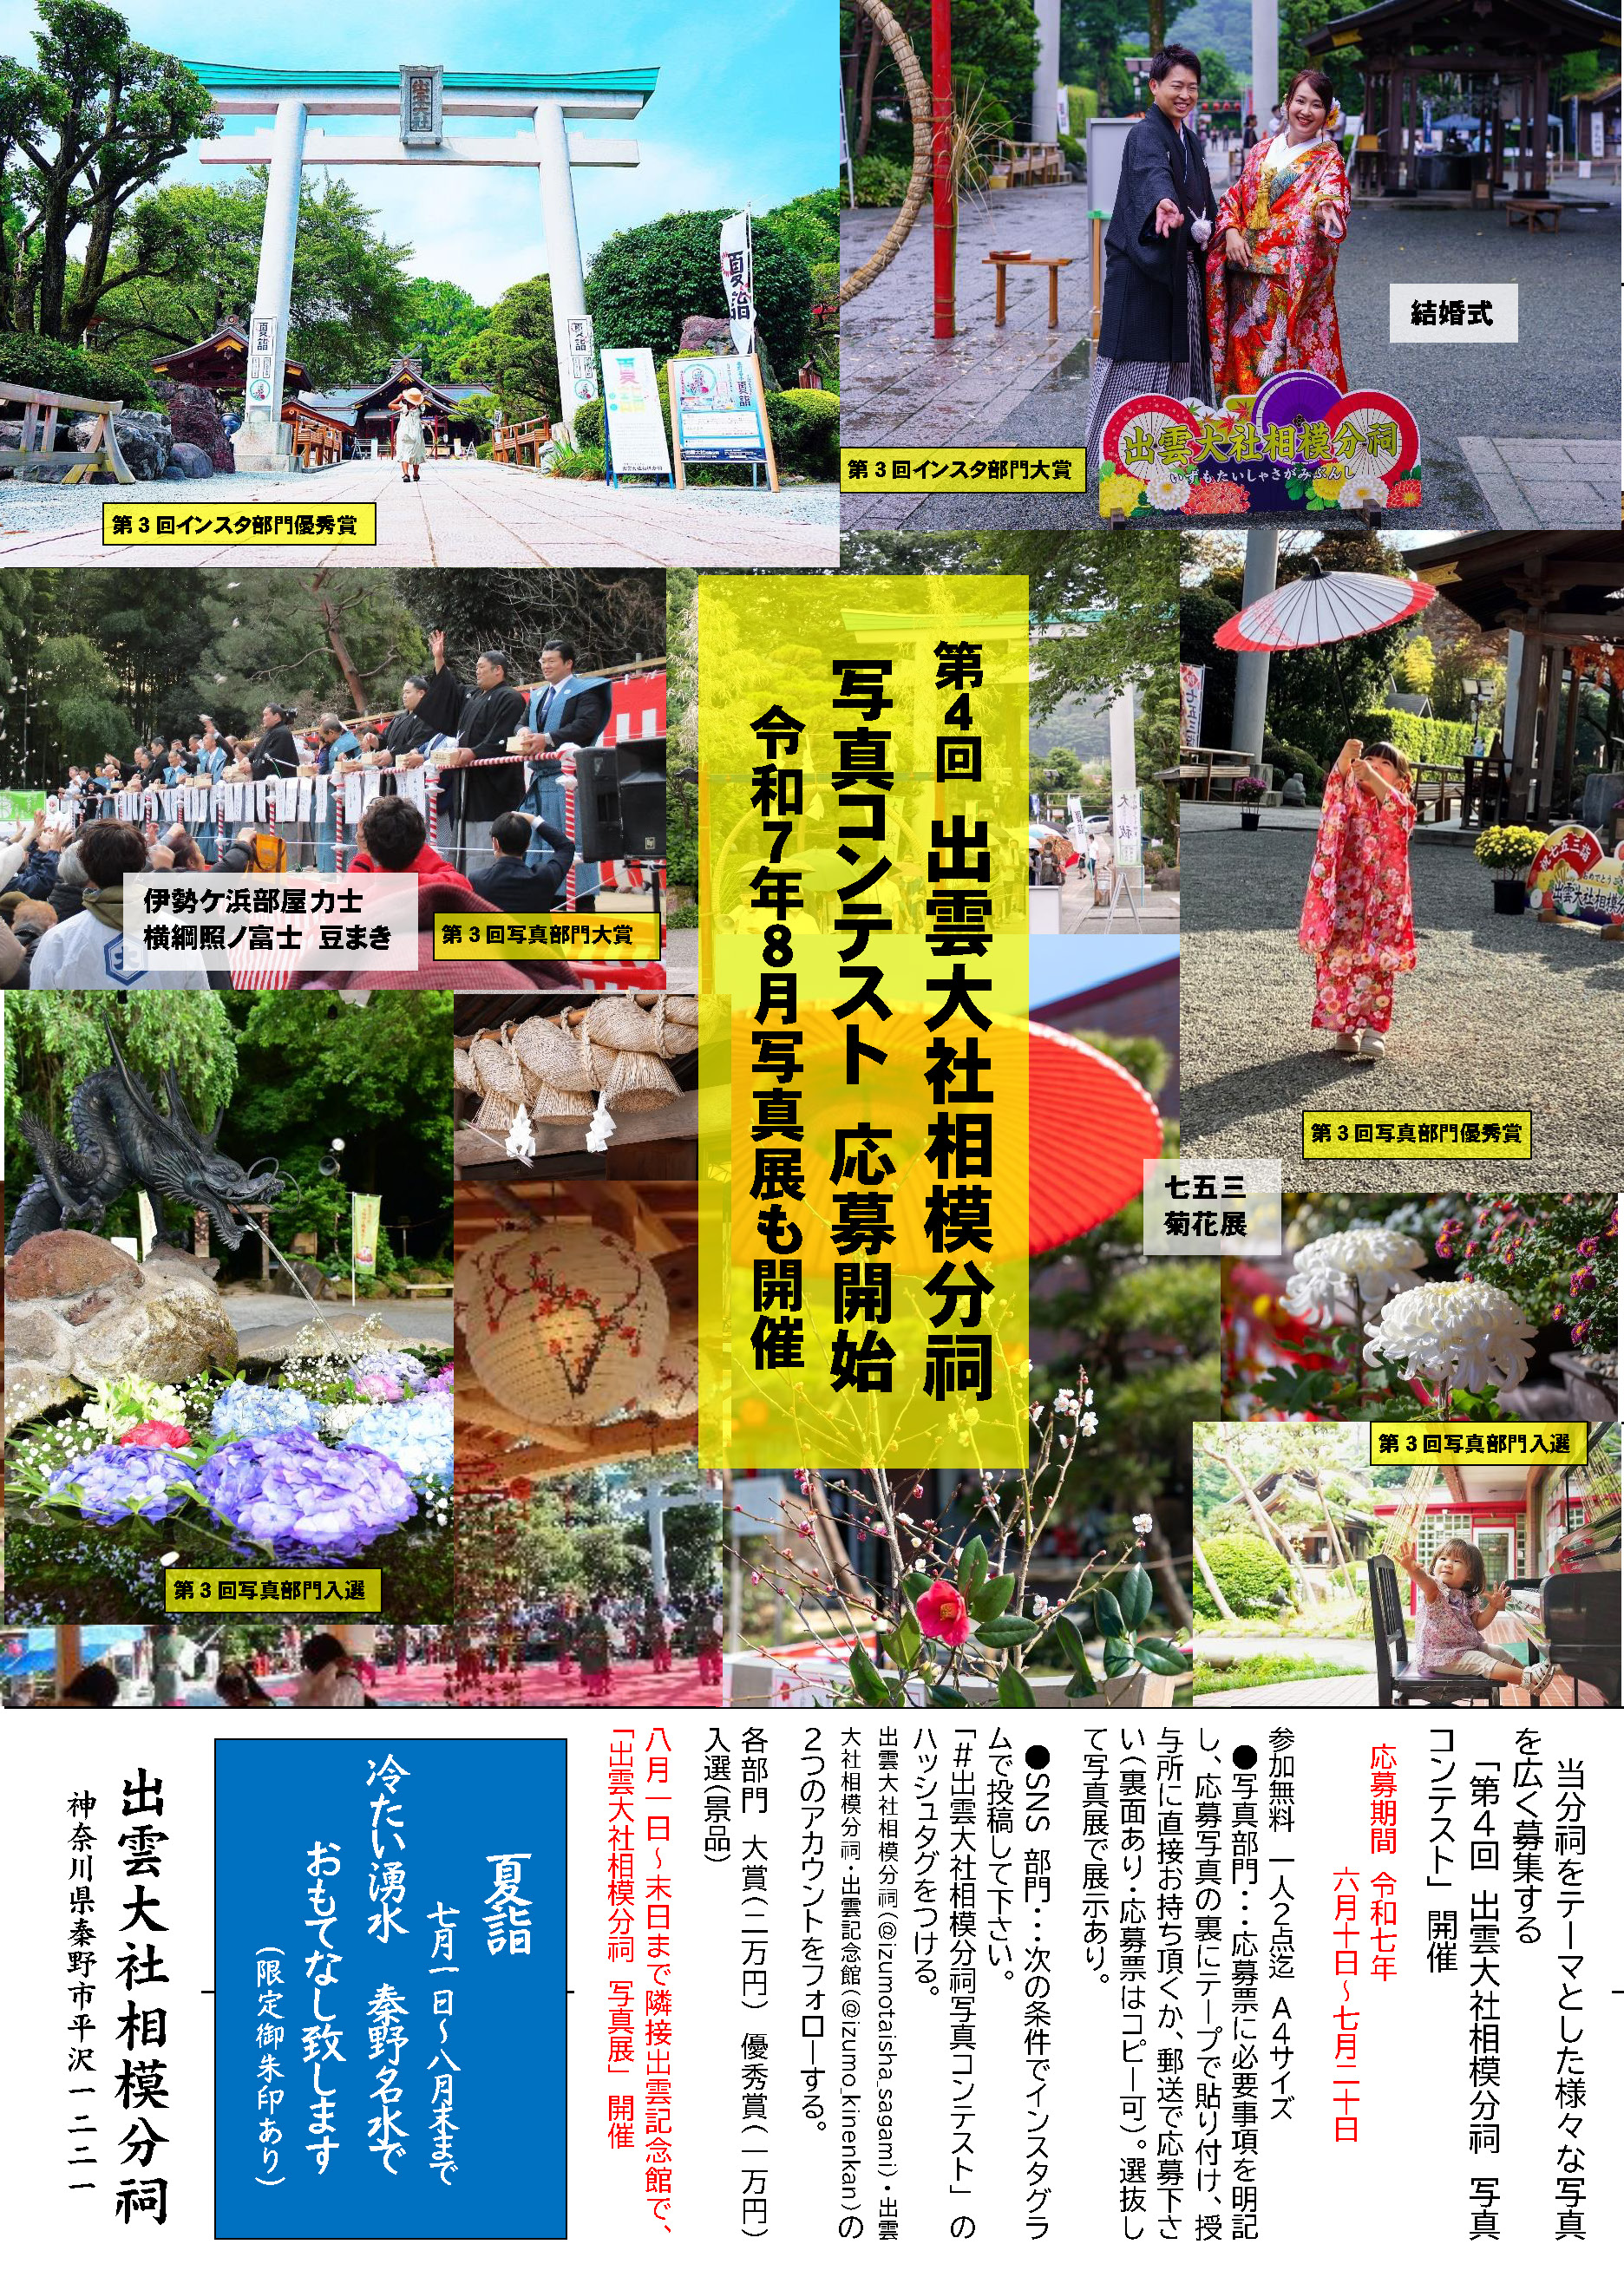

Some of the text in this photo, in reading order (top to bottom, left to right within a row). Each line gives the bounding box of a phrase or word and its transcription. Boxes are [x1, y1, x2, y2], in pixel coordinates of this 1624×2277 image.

[257, 322, 268, 350] 夏詣
[728, 251, 750, 320] 夏詣
[1123, 422, 1399, 466] 出雲大社相模分祠
[1170, 466, 1356, 484] いずもたいしゃさがみぶんし
[749, 704, 806, 1370] 令和7年8月写真展も開催
[829, 660, 896, 1392] 写真コンテスト 応募開始
[923, 815, 995, 1401] 出雲大社相模分祠
[741, 1727, 768, 1813] 各部門
[914, 1729, 940, 1995] ハッシュタグをつける。
[987, 1727, 1013, 1979] ムで投稿して下さい。
[1083, 1729, 1109, 1983] て写真展で展示あり。
[1371, 1744, 1397, 1981] 応募期間 令和七年
[1427, 1730, 1457, 1973] コンテスト」 開催
[1513, 1728, 1543, 1943] を広く募集する
[67, 1790, 97, 2189] 神奈川県秦野市平沢一二二一
[115, 1768, 169, 2225] 出雲大社相模分祠
[301, 1841, 346, 2175] おもてなし致します
[366, 1754, 410, 2175] 冷たい湧水 秦野名水で
[482, 1854, 533, 1955] 夏詣
[1269, 1727, 1294, 2119] 参加無料 一人2点迄 A4サイズ
[1470, 1890, 1500, 2154] 出雲大社相模分祠
[1555, 1758, 1586, 2241] 当分祠をテーマとした様々な写真
[608, 2096, 634, 2149] 開催
[1470, 2178, 1500, 2241] 写真
